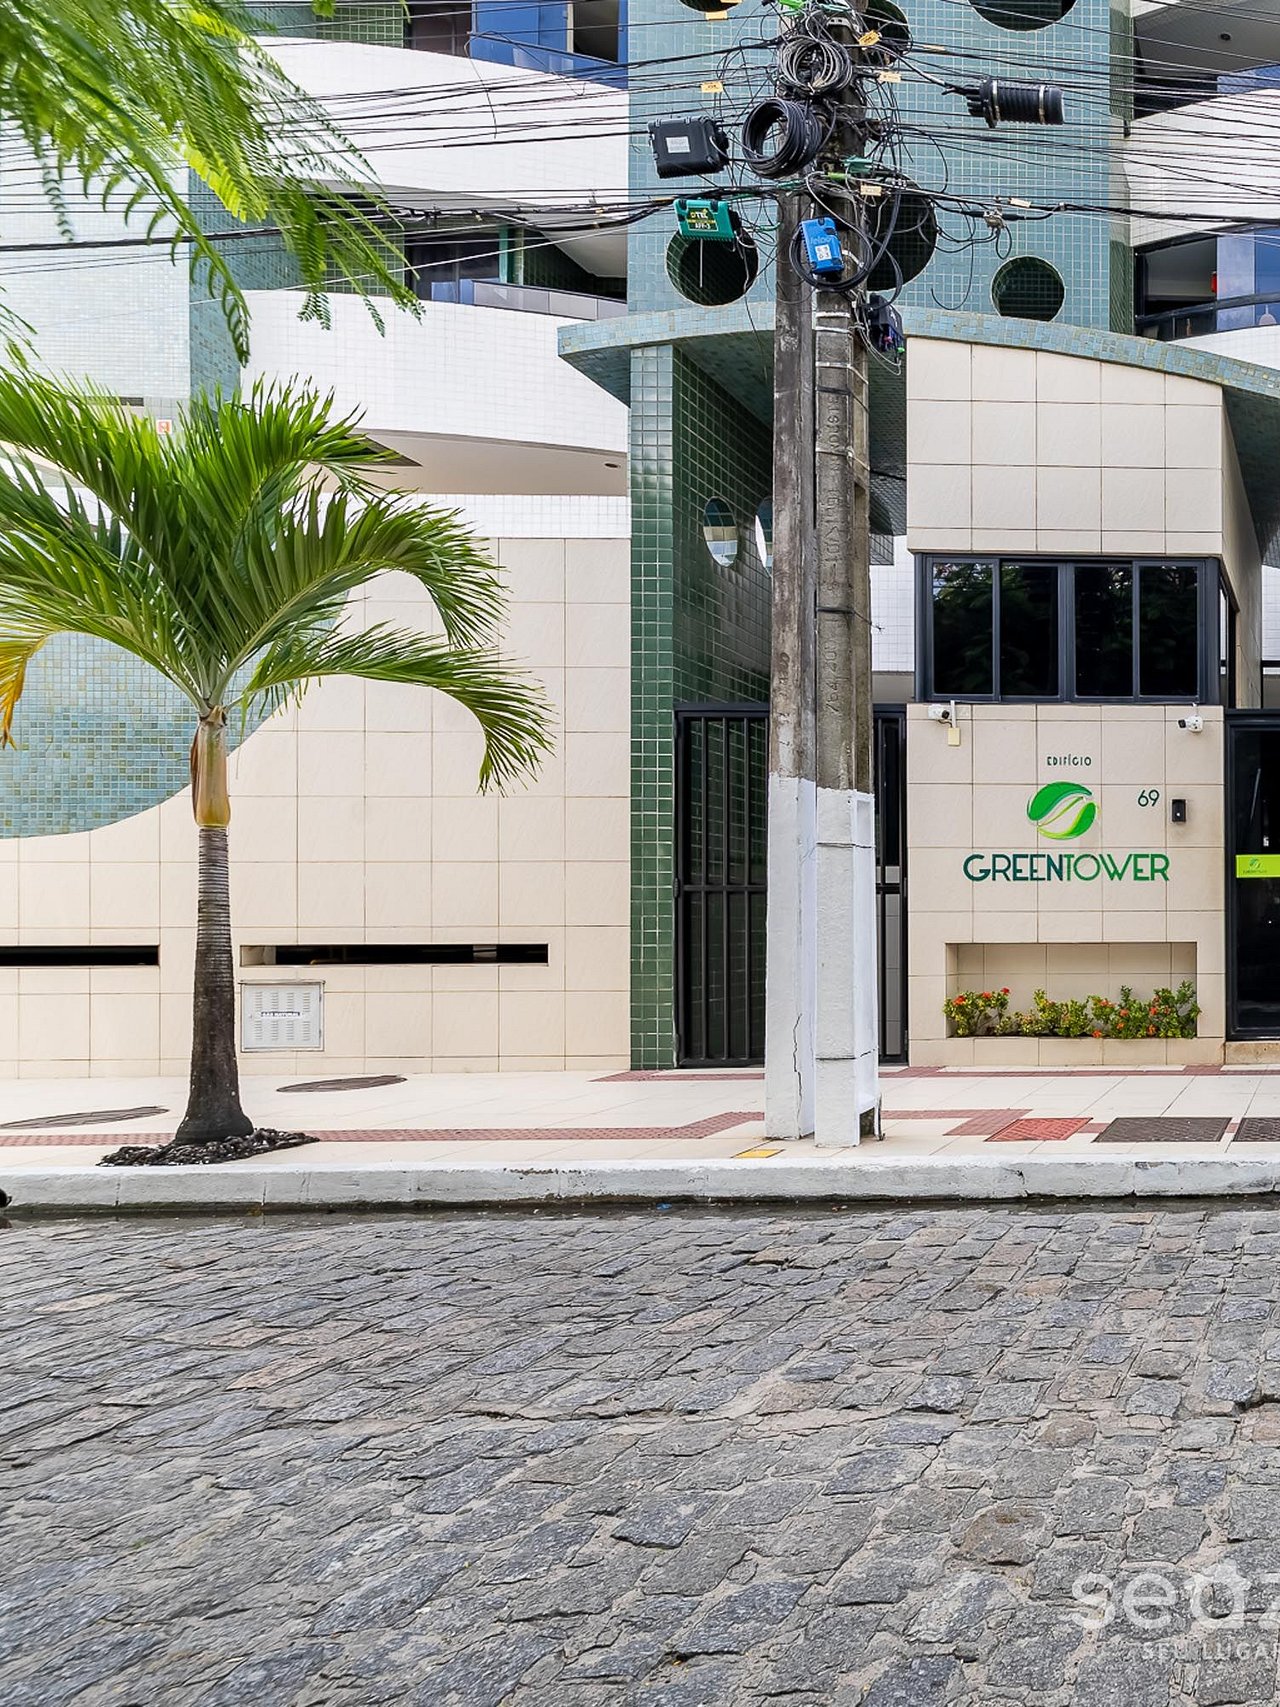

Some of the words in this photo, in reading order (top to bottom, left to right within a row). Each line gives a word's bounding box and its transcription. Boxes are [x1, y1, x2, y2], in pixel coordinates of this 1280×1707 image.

[1046, 753, 1092, 767] EDIFÍCIO
[1137, 789, 1160, 808] 69
[963, 853, 1171, 882] GREENTOWER
